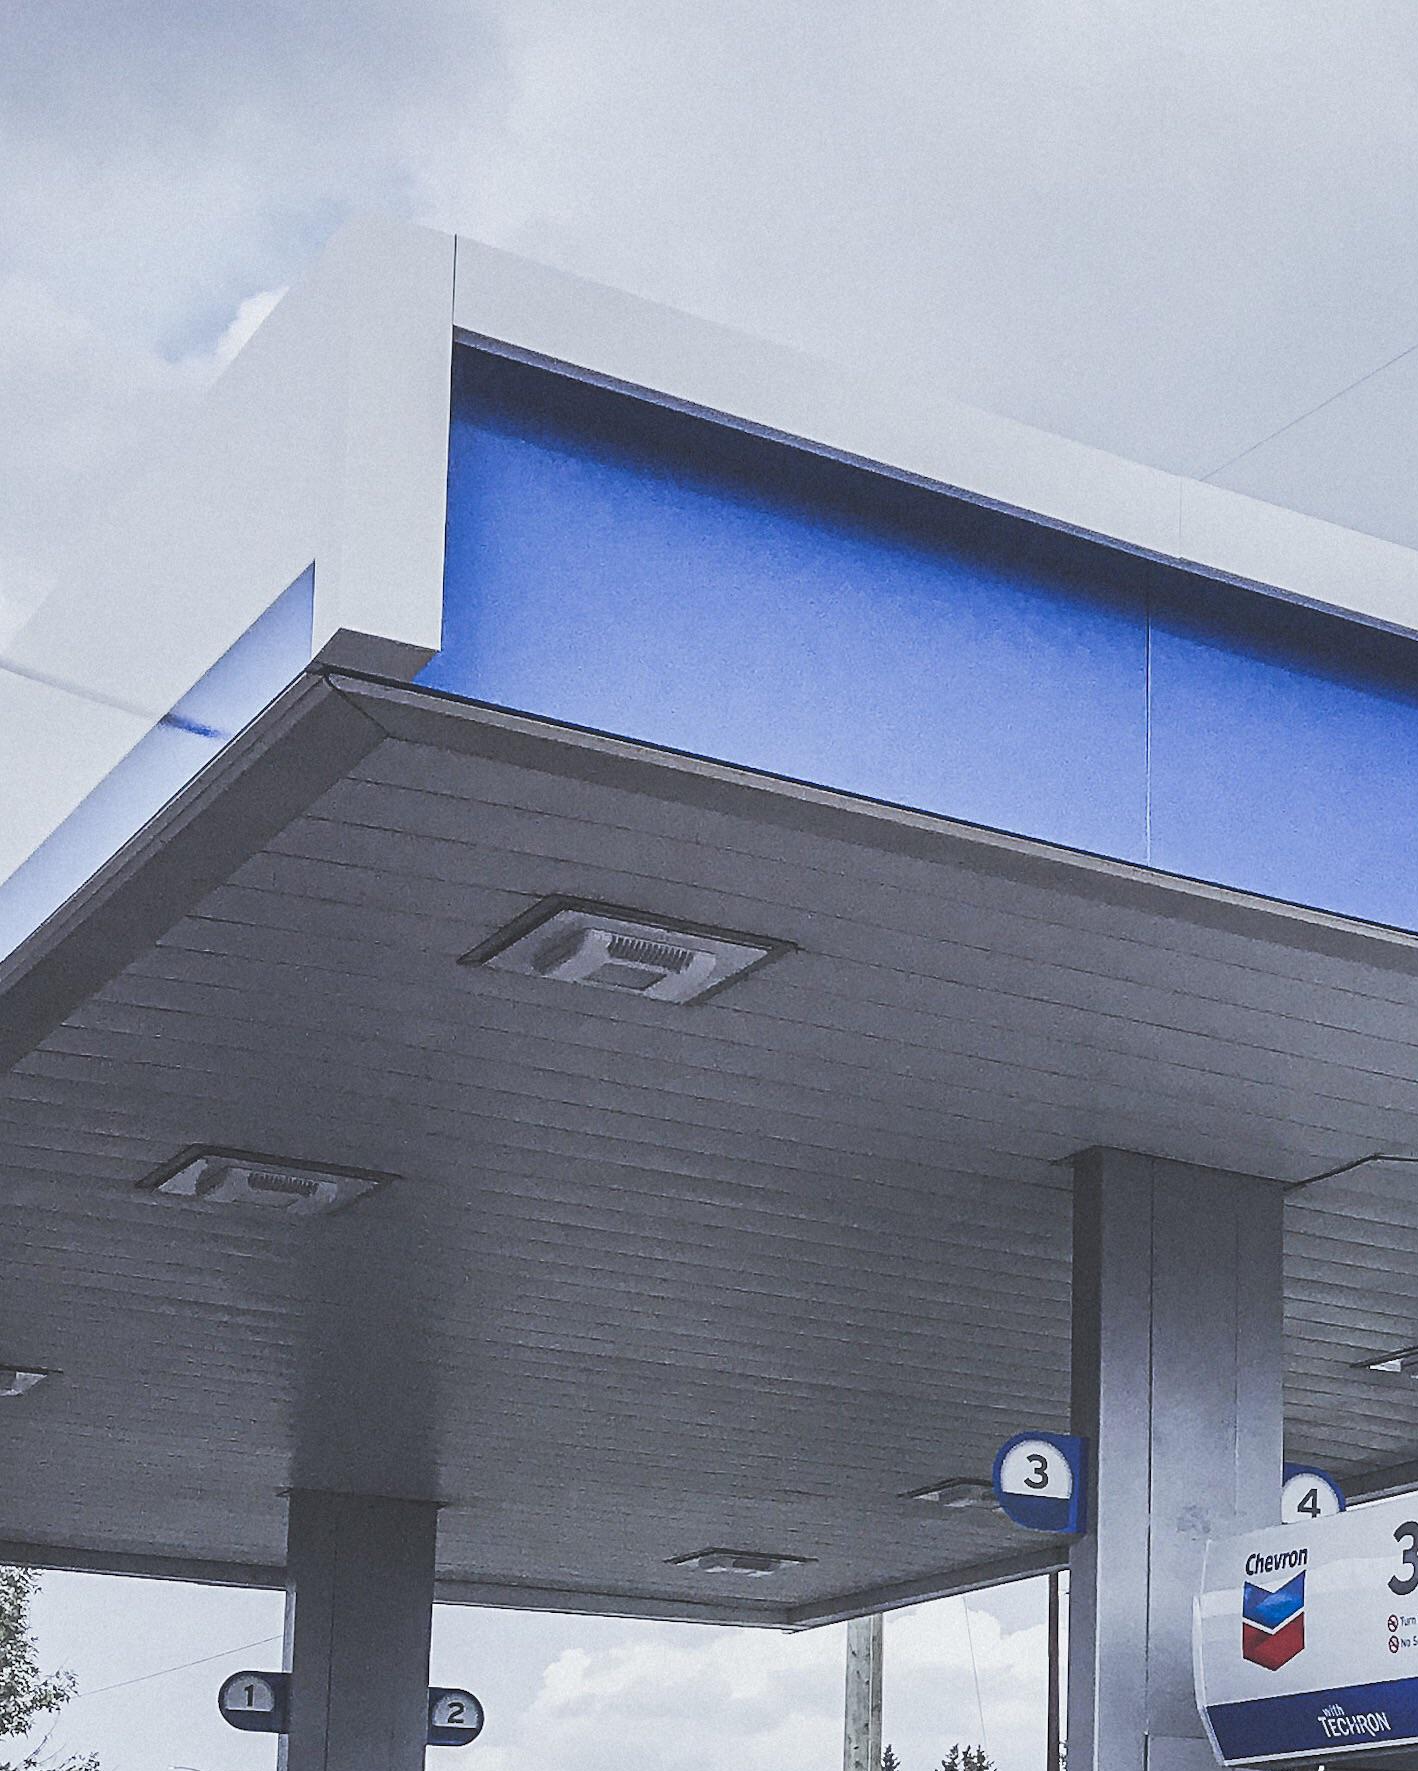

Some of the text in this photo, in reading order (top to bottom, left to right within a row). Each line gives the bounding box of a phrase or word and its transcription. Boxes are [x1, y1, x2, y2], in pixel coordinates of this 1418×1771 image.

[1023, 1453, 1049, 1490] 3
[1296, 1487, 1321, 1518] 4
[1245, 1547, 1309, 1577] Chevron
[1399, 1615, 1417, 1627] Turn
[1400, 1638, 1411, 1649] No
[243, 1683, 254, 1708] 1
[446, 1701, 465, 1725] 2
[1321, 1703, 1346, 1718] with
[1317, 1711, 1392, 1738] TECHRON
